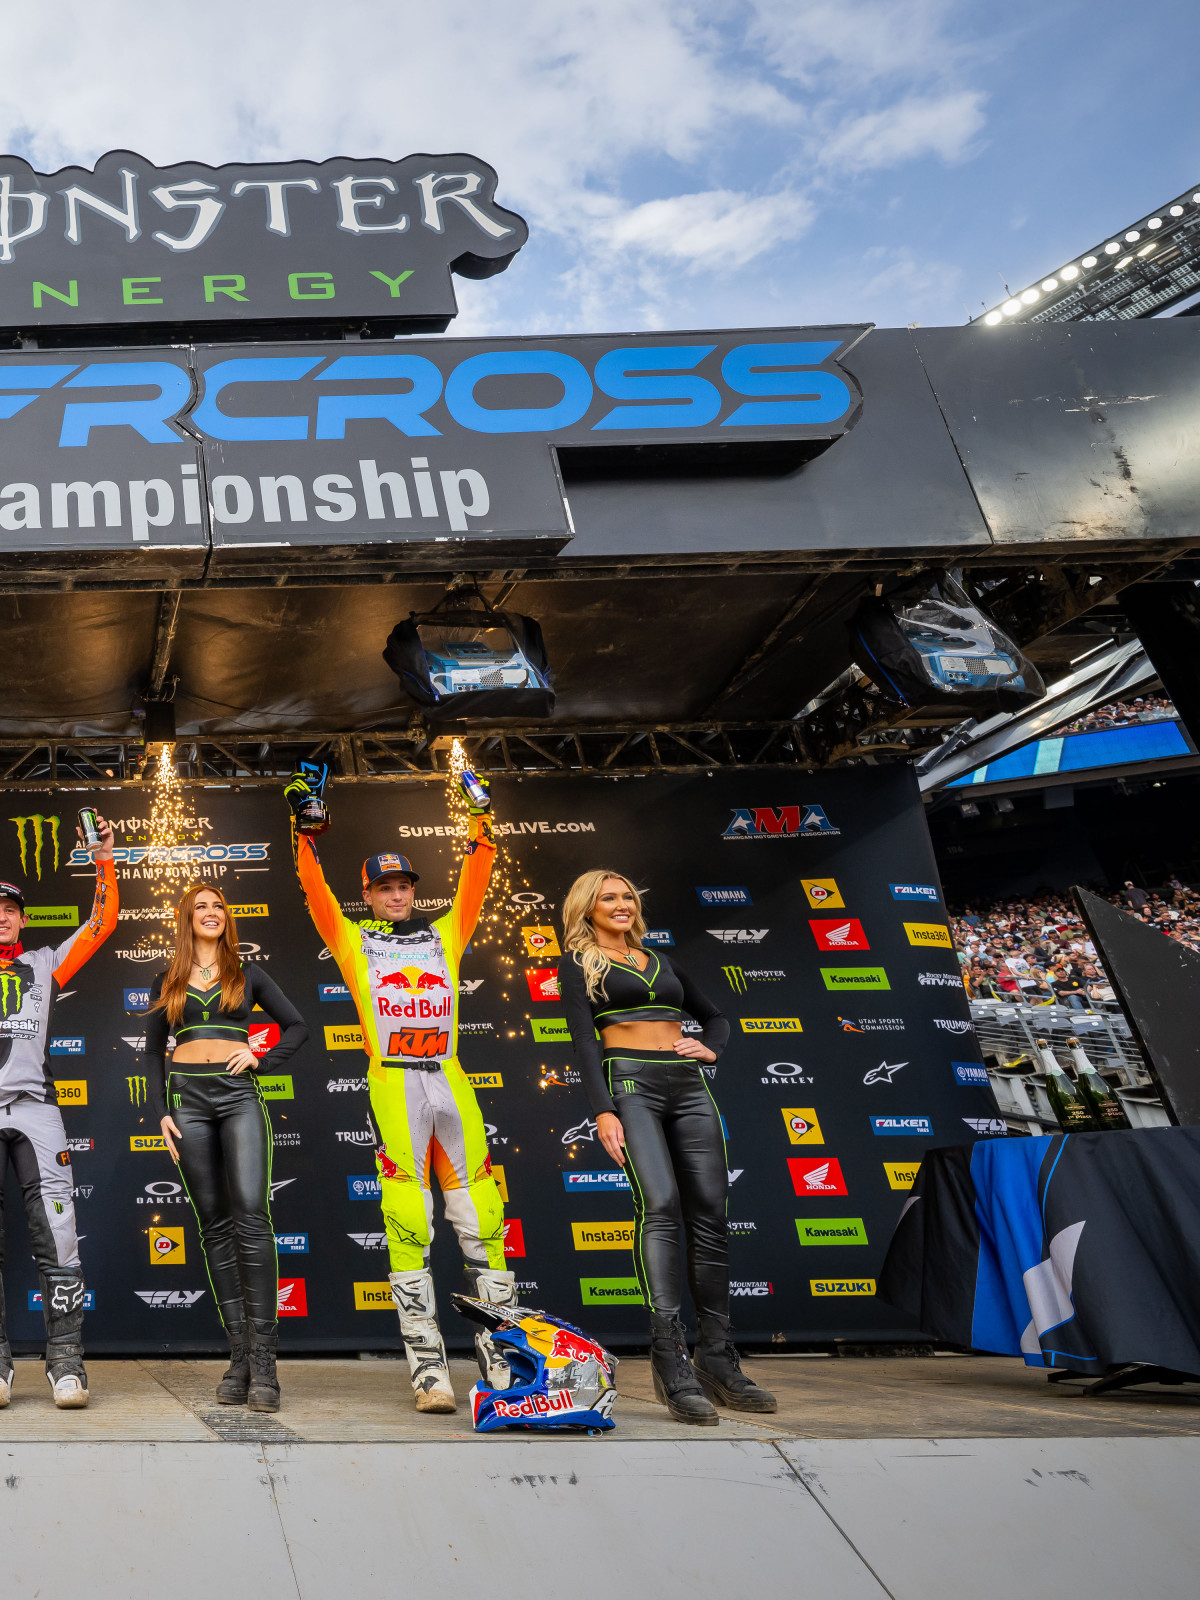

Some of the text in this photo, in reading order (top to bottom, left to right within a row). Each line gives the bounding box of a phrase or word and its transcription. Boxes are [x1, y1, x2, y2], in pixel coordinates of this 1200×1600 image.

[721, 804, 840, 836] AMA
[711, 890, 747, 899] YAMAHA
[894, 886, 936, 895] FALKEN
[28, 912, 72, 921] Kawasaki
[706, 929, 769, 940] FLY
[912, 930, 947, 941] Insta360
[744, 970, 786, 978] MONSTER
[830, 974, 881, 984] Kawasaki
[378, 996, 451, 1018] Red Bull
[745, 1021, 798, 1029] SUZUKI
[388, 1027, 450, 1058] KTM
[875, 1119, 929, 1128] FALKEN
[136, 1196, 190, 1204] OAKLEY
[805, 1226, 858, 1237] Kawasaki
[589, 1286, 642, 1297] Kawasak
[815, 1283, 872, 1292] SUZUKI
[134, 1291, 205, 1304] FLY
[494, 1390, 573, 1418] Red Bull
